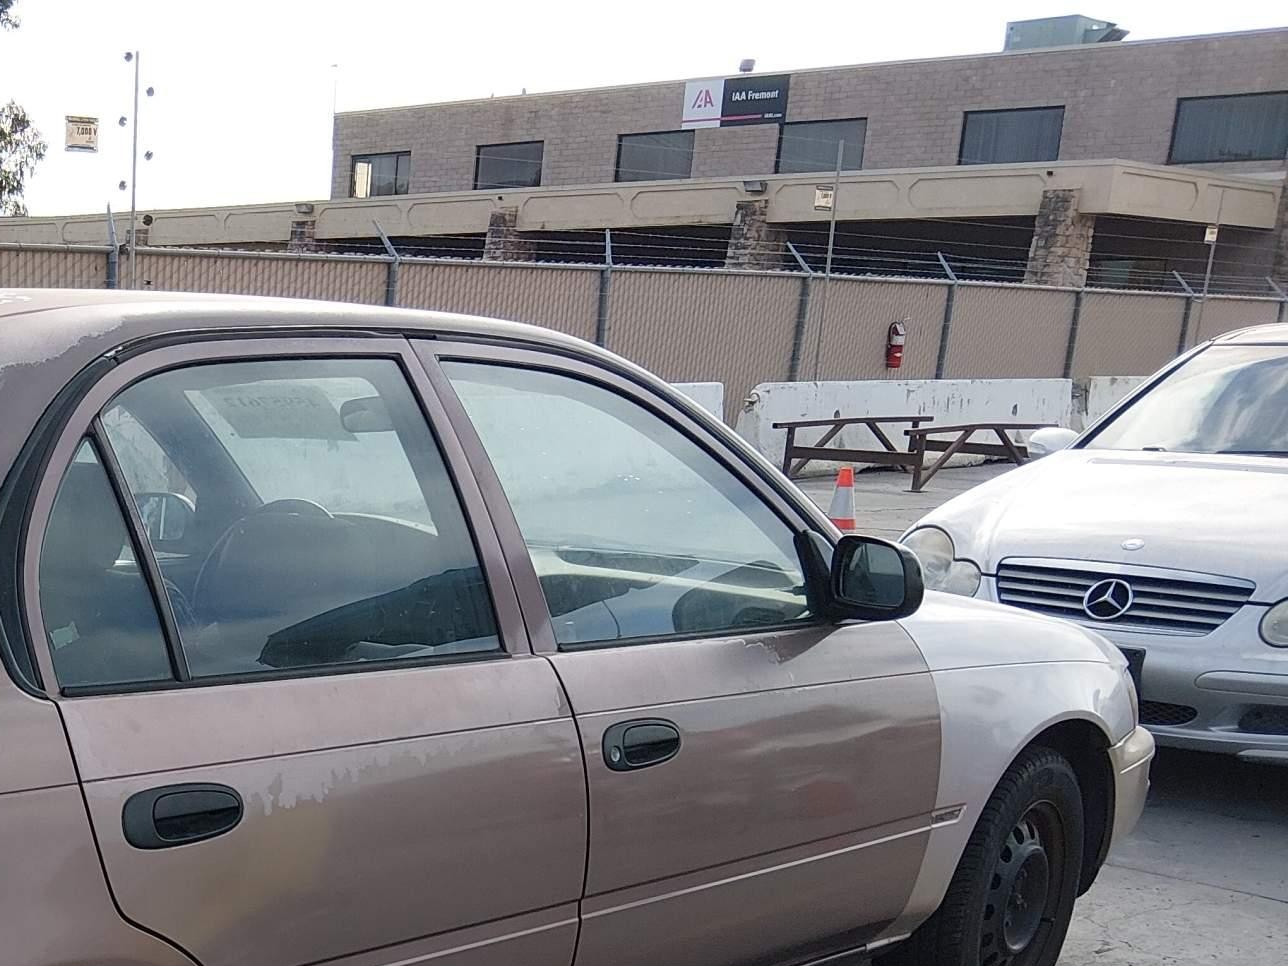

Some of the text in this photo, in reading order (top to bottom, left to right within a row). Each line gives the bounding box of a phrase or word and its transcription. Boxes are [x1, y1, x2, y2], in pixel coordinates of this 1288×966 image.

[732, 90, 779, 101] IAA Fremont
[76, 126, 92, 137] 7,000
